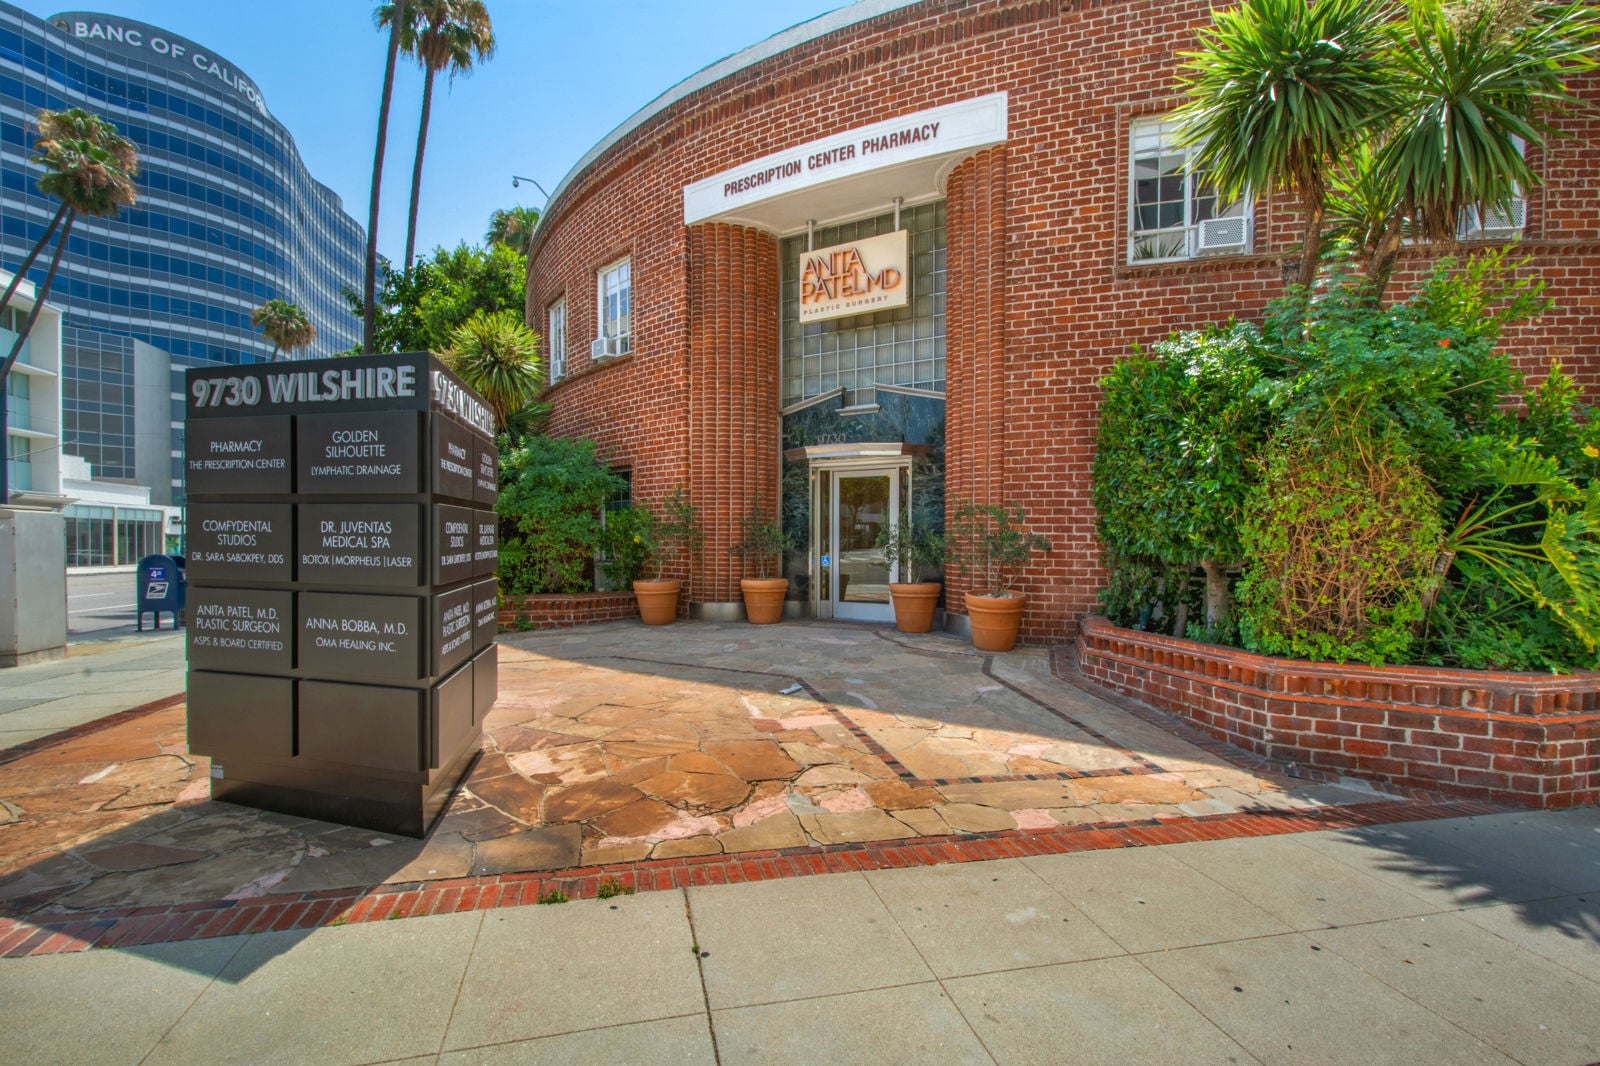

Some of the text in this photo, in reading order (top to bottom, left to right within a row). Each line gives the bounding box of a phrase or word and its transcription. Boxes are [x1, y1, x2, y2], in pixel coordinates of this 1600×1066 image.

[74, 21, 268, 118] BANC OF CALIFOR
[723, 121, 940, 197] PRESCRIPTION CENTER PHARMACY
[801, 247, 867, 283] ANITA
[800, 267, 901, 305] PATEL MD
[192, 365, 416, 408] 9730 WILSHIRE
[332, 430, 379, 443] GOLDEN
[816, 433, 847, 445] 9730
[210, 440, 263, 453] PHARMACY
[325, 445, 386, 458] SILHOUETTE
[189, 458, 286, 470] THE PRESCRIPTION CENTER
[311, 464, 401, 476] LYMPHATIC DRAINAGE
[202, 519, 272, 533] COMFYDENTAL
[320, 521, 392, 534] DR. JUVENTAS
[217, 534, 257, 546] STUDIOS
[322, 536, 391, 549] MEDICAL SPA
[192, 551, 204, 561] DR.
[205, 551, 225, 562] SARA
[268, 553, 284, 564] DDS
[302, 554, 330, 565] BOTOX
[197, 604, 279, 620] ANITA PATEL, M.D.
[196, 617, 281, 633] PLASTIC SURGEON
[305, 618, 409, 636] ANNA BOBBA, M.D.
[194, 636, 284, 651] ASPS & BOARD CERTIFIED
[315, 637, 397, 653] OMA HEALING INC.
